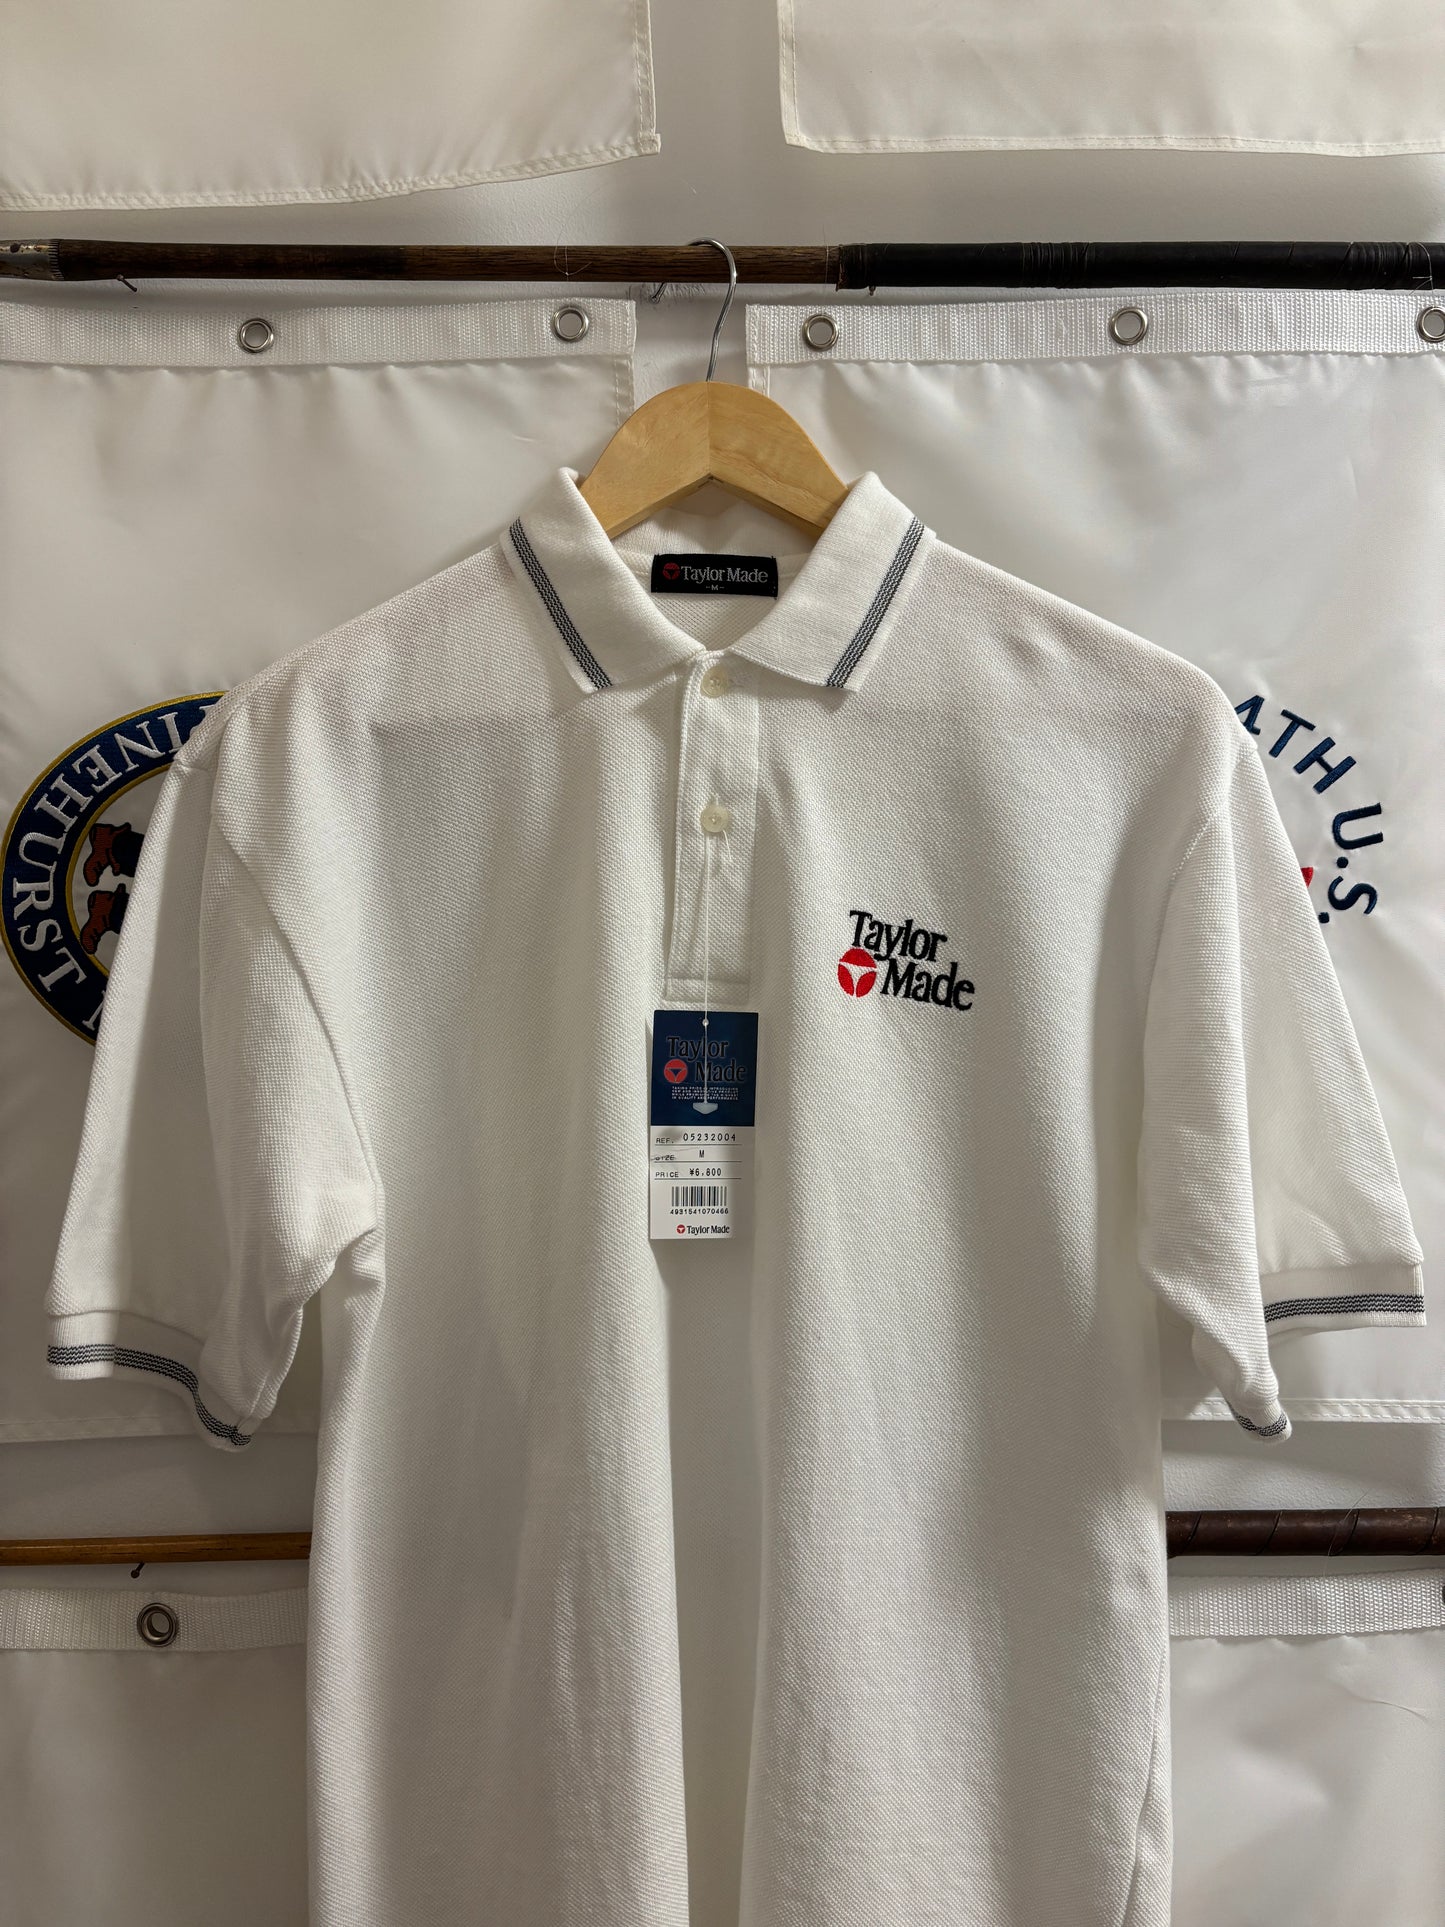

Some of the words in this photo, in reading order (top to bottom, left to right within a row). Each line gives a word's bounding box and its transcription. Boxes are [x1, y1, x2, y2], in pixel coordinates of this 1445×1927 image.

[681, 566, 726, 584] Taylor
[726, 567, 769, 583] Made
[13, 704, 217, 992] INEHURST
[849, 910, 948, 962] Taylor
[880, 958, 975, 1011] Made
[666, 1036, 729, 1062] Taylor
[694, 1058, 747, 1082] Made
[683, 1133, 736, 1142] 05232004
[699, 1149, 705, 1158] M
[689, 1168, 722, 1177] ¥6,800
[687, 1225, 710, 1235] Taylor
[711, 1225, 730, 1234] Made
